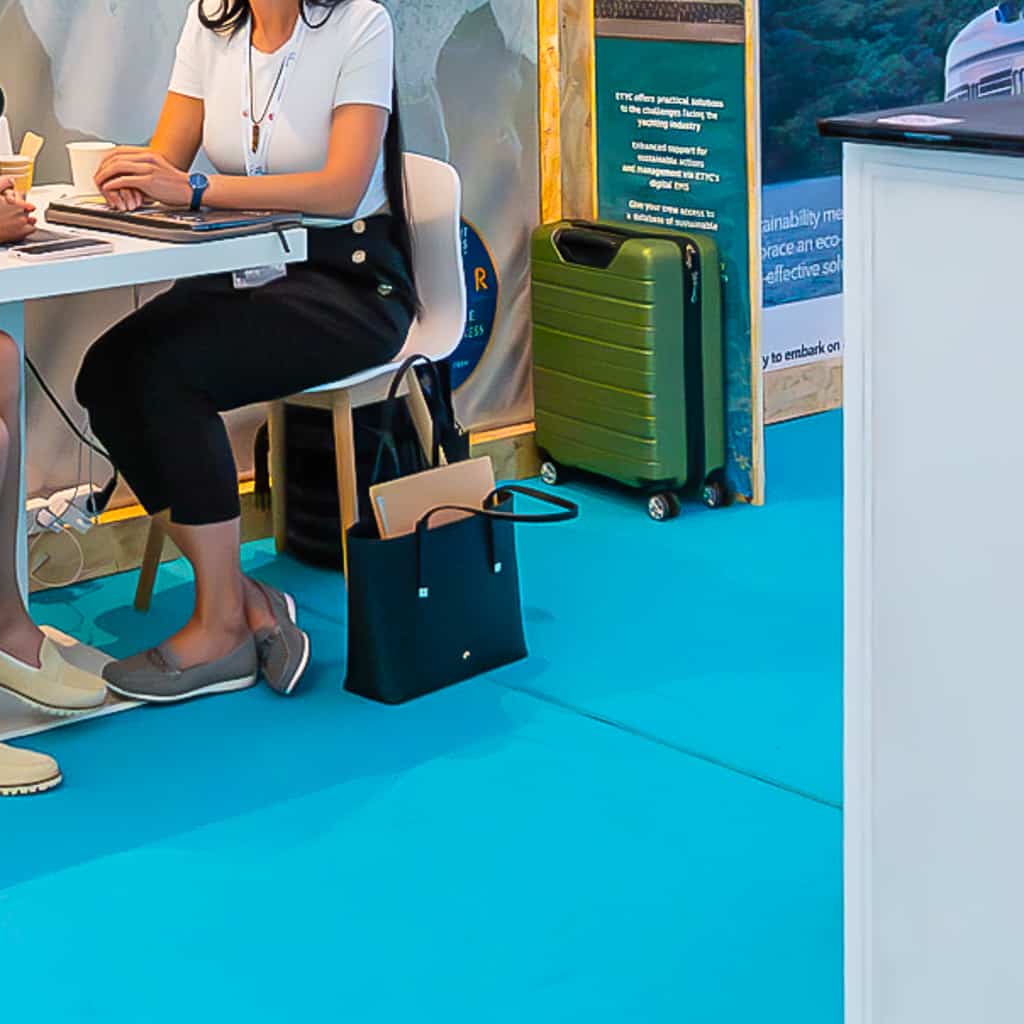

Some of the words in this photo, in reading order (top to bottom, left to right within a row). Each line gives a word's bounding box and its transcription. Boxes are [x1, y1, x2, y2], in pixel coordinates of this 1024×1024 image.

[797, 239, 813, 253] an
[822, 254, 843, 275] sol
[771, 351, 782, 364] to
[784, 340, 825, 361] embark
[827, 341, 840, 353] on
